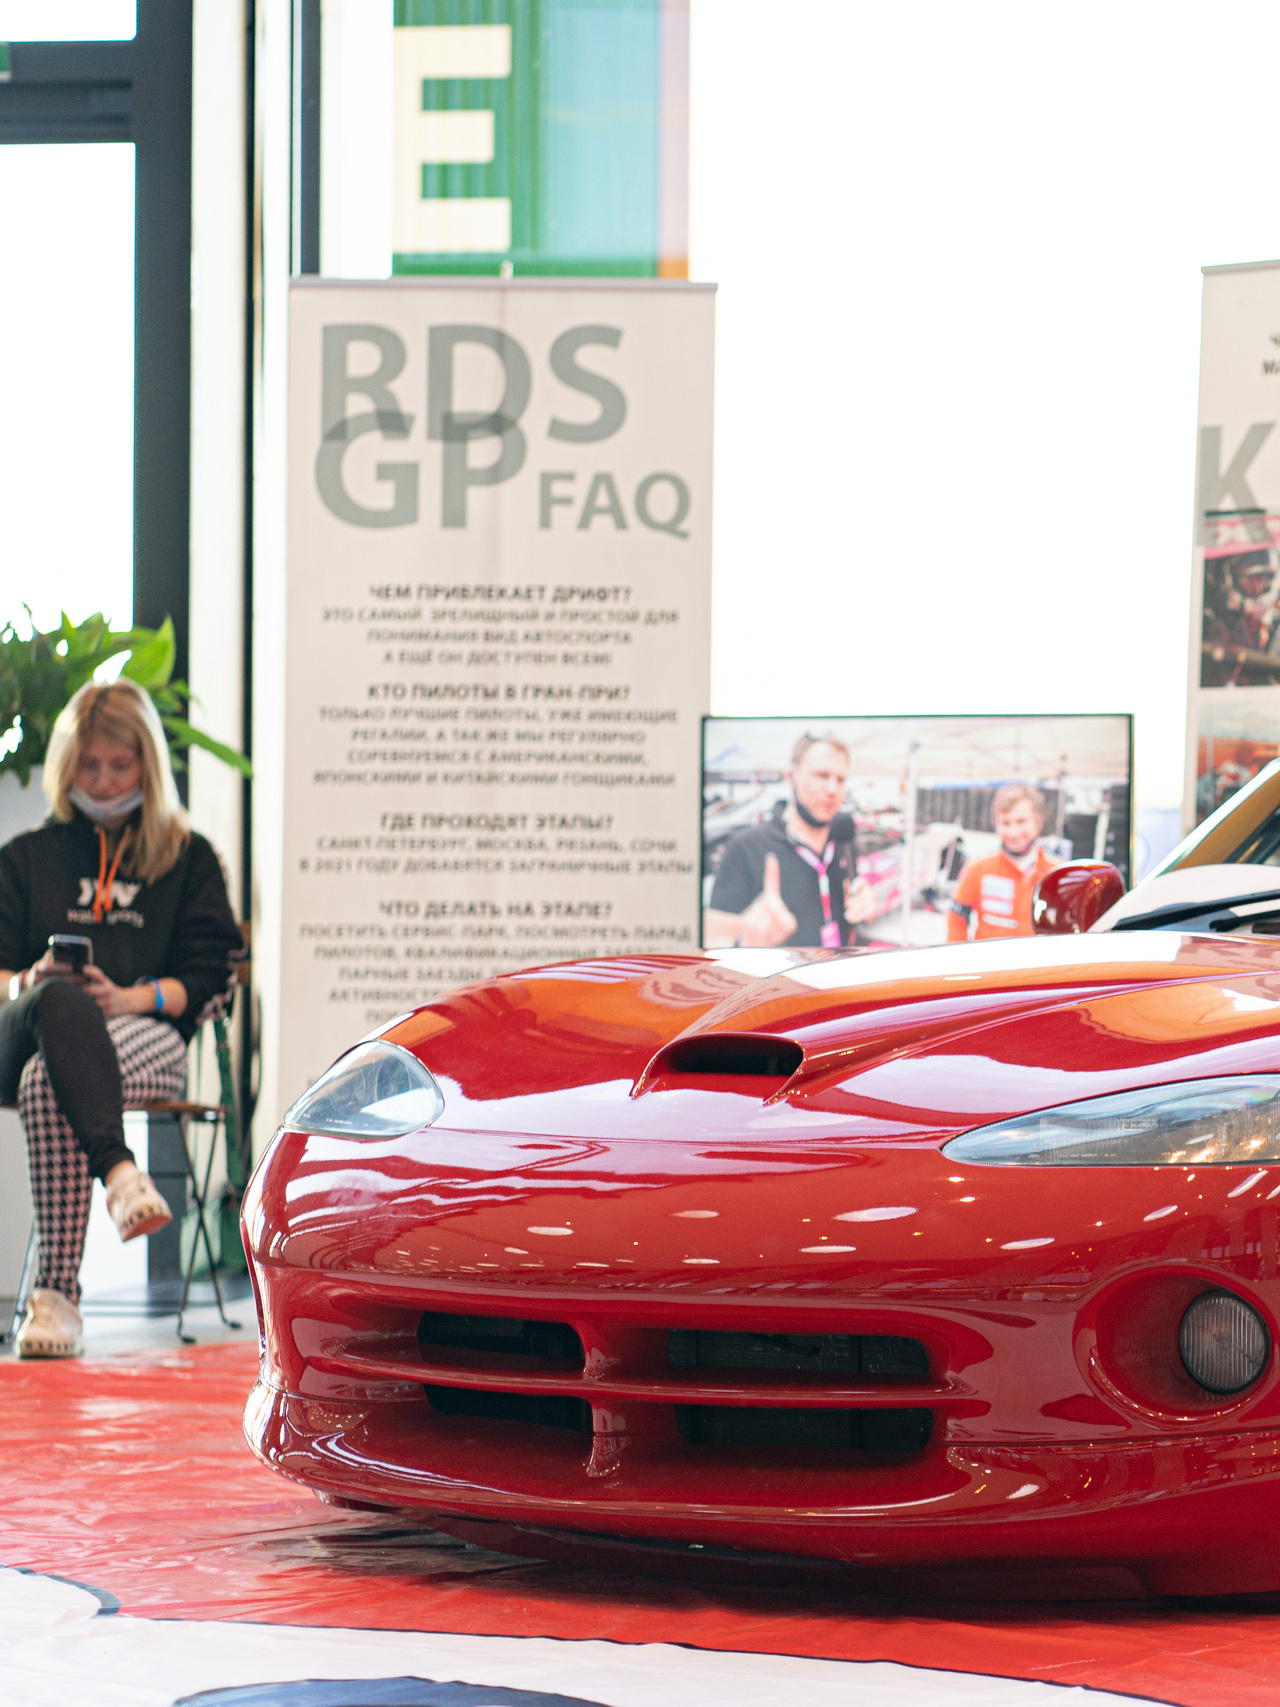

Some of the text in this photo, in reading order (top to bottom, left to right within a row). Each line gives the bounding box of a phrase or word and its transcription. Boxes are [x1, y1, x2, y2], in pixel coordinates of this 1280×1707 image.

[321, 323, 627, 444] RDS
[315, 410, 692, 541] GP FAQ
[370, 586, 631, 603] ЧЕМ ПРИВЛЕКАЕТ ДРИФТ?
[368, 685, 406, 700] КТО
[412, 685, 498, 700] ПИЛОТЫ
[522, 685, 630, 700] ГРАН-ПРИ?
[381, 813, 613, 831] ГДЕ ПРОХОДЯТ ЭТАПЫ?
[380, 902, 612, 920] ЧТО ДЕЛАТЬ НА ЭТАПЕ?
